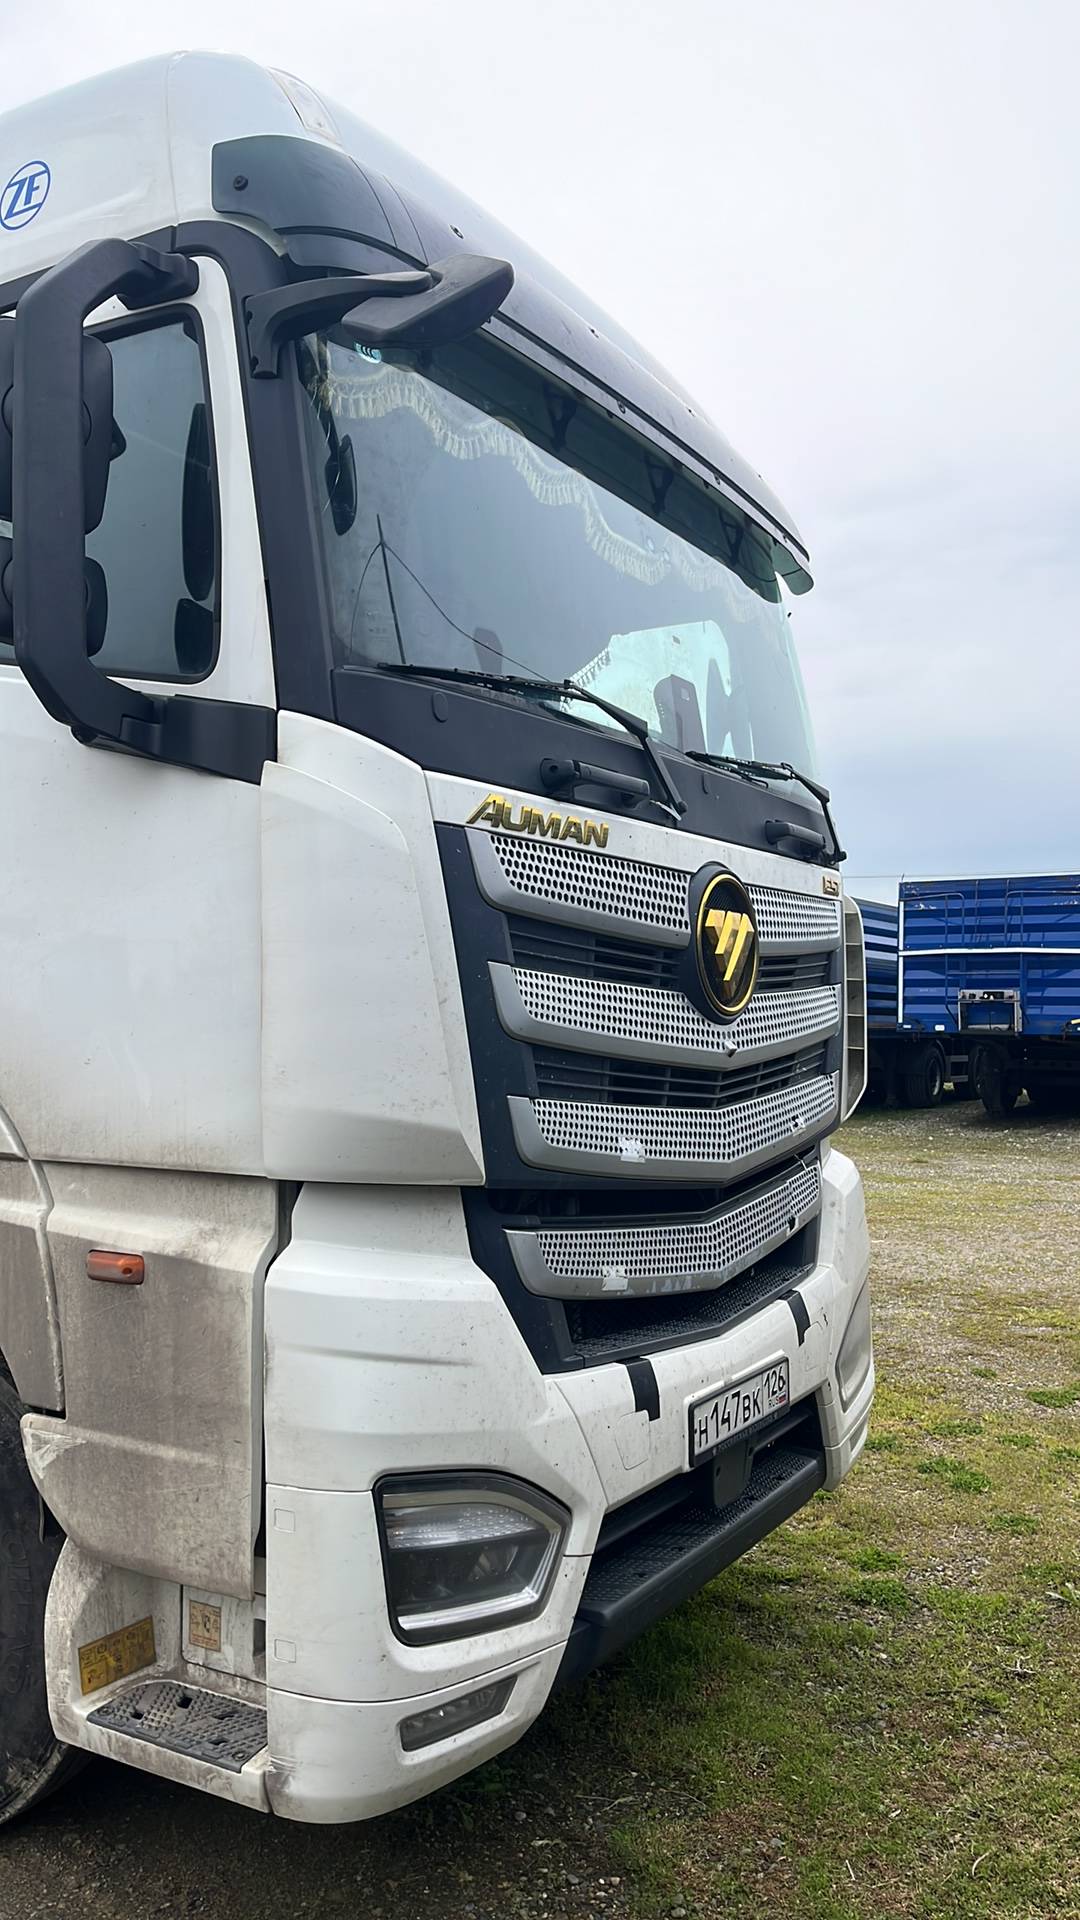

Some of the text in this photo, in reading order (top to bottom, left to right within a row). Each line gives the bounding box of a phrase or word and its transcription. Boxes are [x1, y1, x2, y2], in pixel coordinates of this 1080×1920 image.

[3, 167, 49, 221] ZF
[466, 793, 609, 849] AUMAN
[763, 1365, 787, 1399] 126
